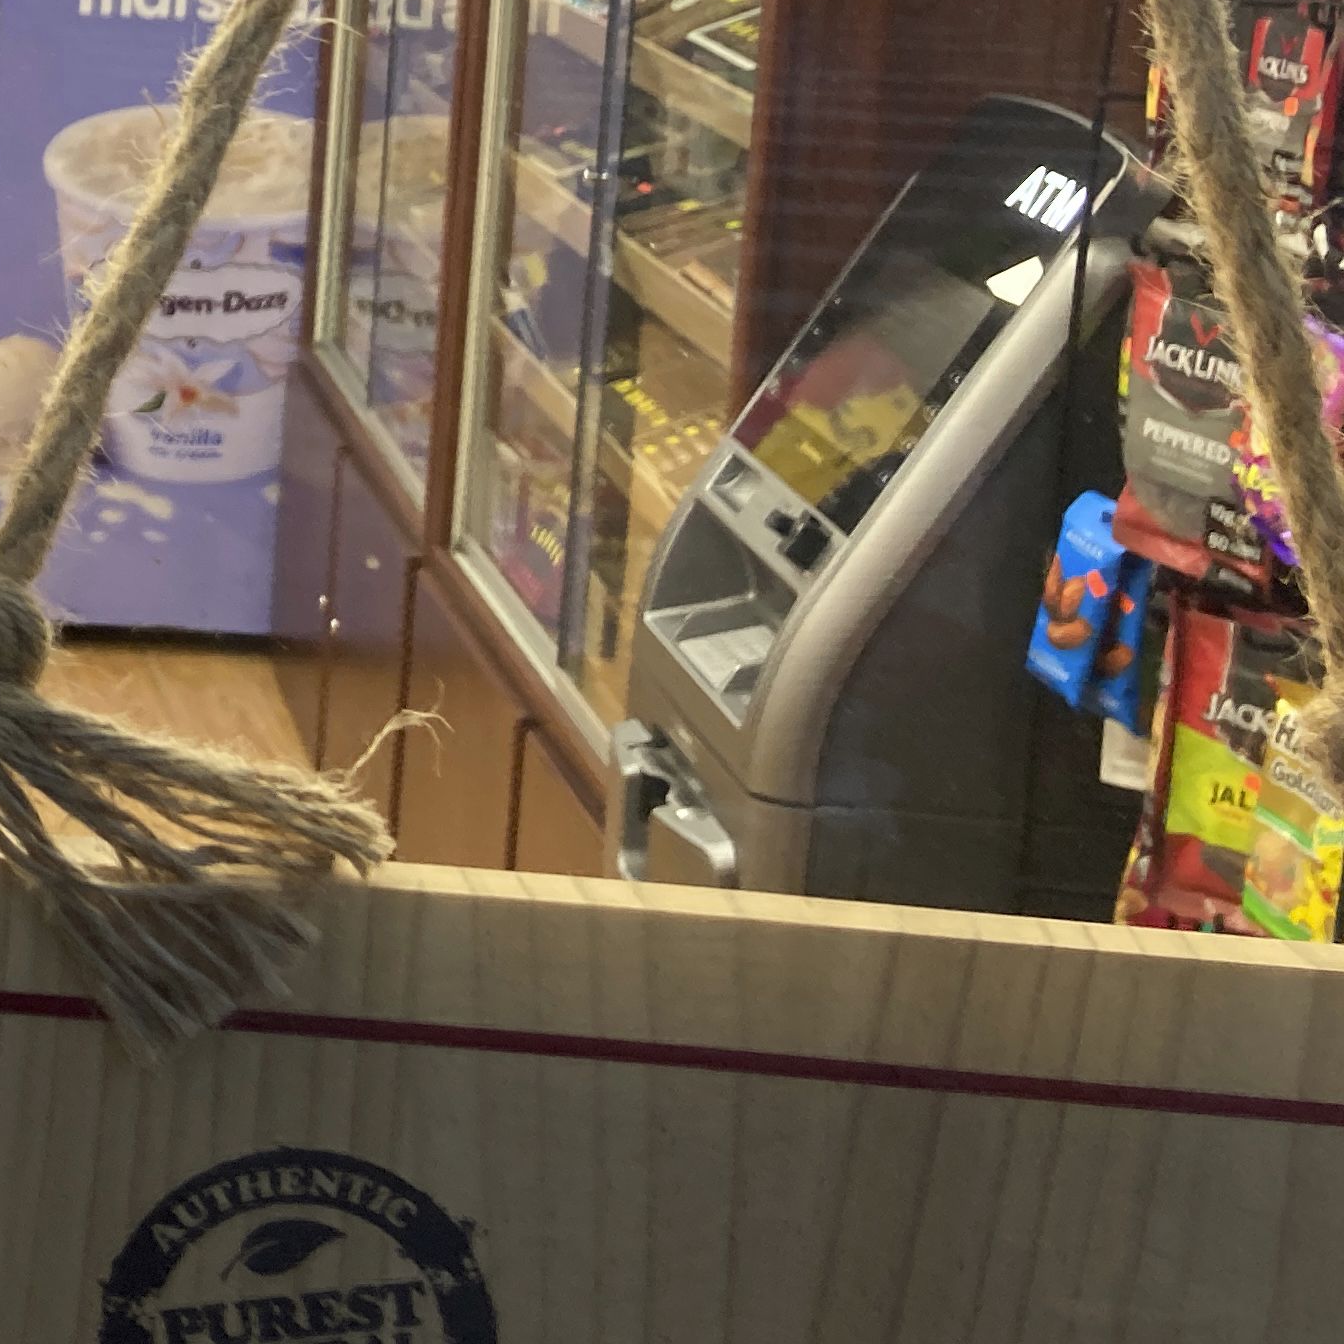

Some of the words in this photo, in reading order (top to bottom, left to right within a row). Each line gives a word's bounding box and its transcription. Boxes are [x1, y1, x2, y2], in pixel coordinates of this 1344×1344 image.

[1004, 166, 1088, 233] ATM
[1144, 335, 1194, 378] JACK
[1143, 416, 1232, 466] PEPPERED
[150, 1165, 418, 1255] AUTHENTIC
[162, 1280, 427, 1344] PUREST
